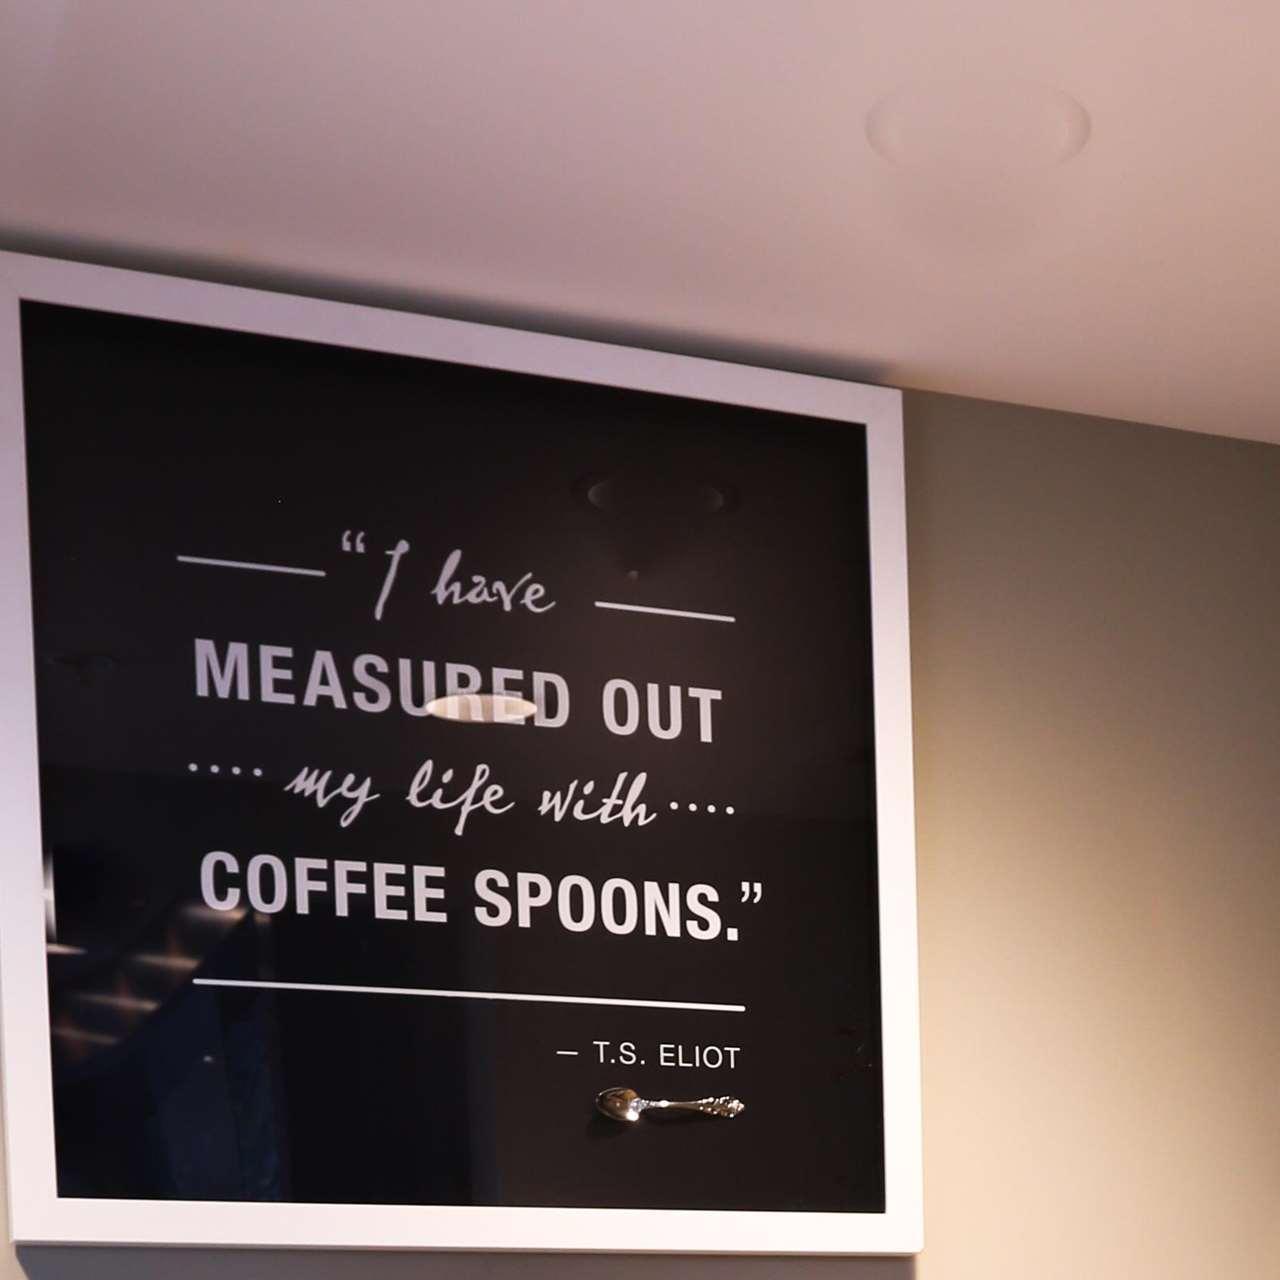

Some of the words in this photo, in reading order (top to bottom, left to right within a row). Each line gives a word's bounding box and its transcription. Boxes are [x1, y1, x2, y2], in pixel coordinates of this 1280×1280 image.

[431, 549, 556, 613] have
[194, 638, 570, 729] MEASURED
[602, 678, 722, 743] OUT
[284, 766, 380, 826] my
[406, 759, 515, 836] life
[538, 771, 657, 827] with
[200, 851, 447, 923] COFFEE
[474, 869, 763, 942] SPOONS.”
[593, 1040, 645, 1067] T.S.
[659, 1042, 741, 1070] ELIOT
